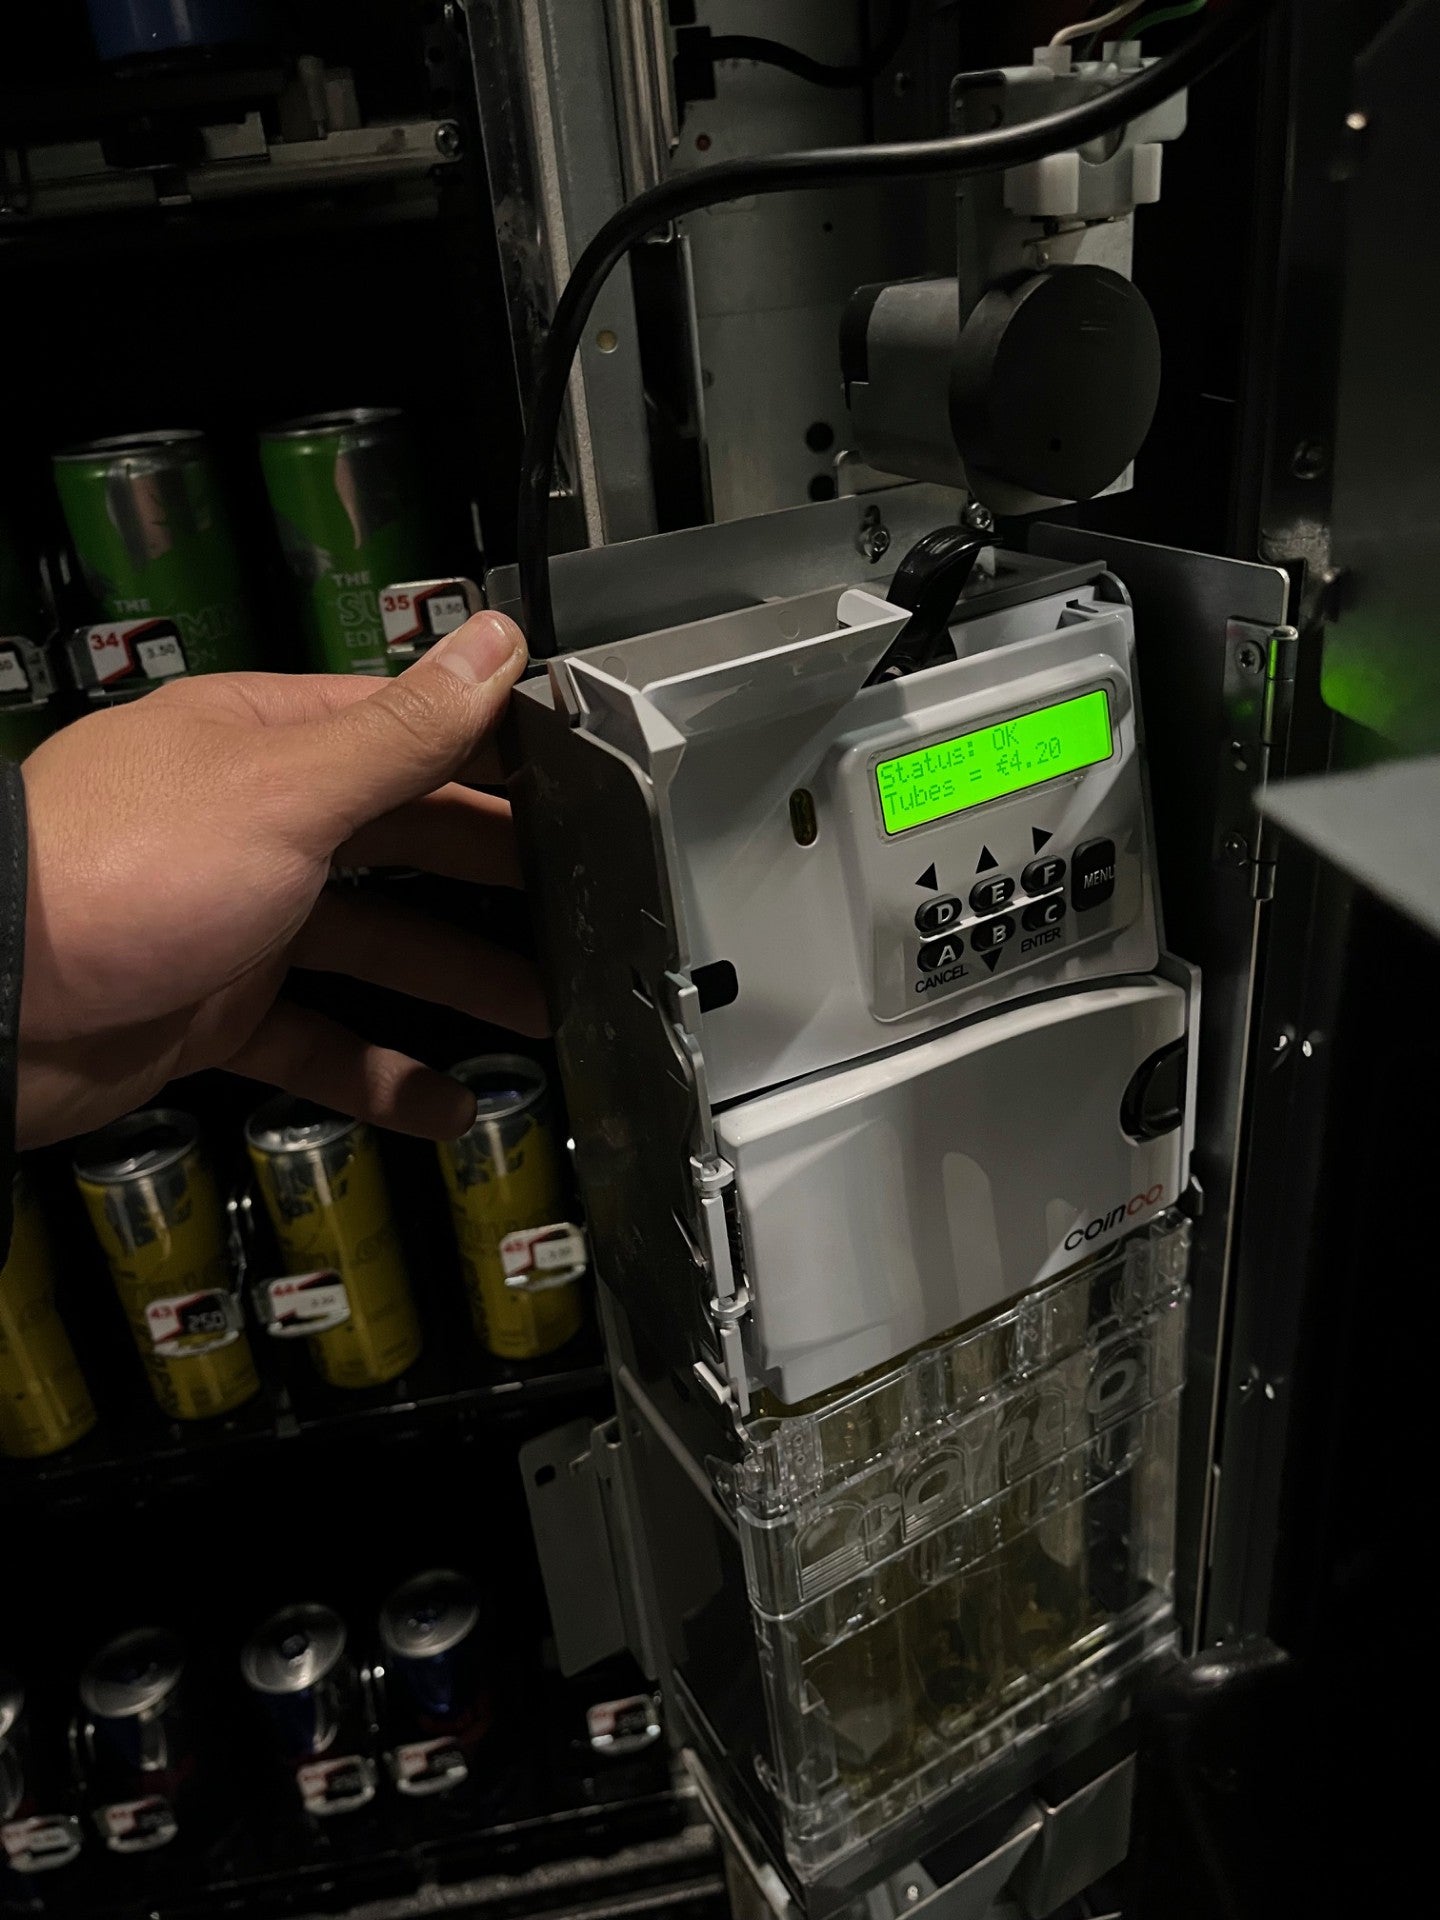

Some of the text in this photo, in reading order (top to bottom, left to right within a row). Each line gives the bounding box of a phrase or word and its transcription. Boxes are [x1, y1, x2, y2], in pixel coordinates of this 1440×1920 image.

[384, 595, 411, 612] 35
[91, 632, 119, 650] 34
[881, 722, 1020, 789] Status: OK
[884, 779, 956, 815] Tubes
[996, 736, 1062, 777] €4.20
[1043, 864, 1056, 884] F
[991, 882, 1005, 901] E
[937, 903, 954, 924] D
[1044, 905, 1058, 924] C
[992, 926, 1007, 945] B
[1020, 927, 1062, 953] ENTER
[937, 945, 957, 967] A
[915, 965, 969, 994] CANCEL
[1063, 1183, 1164, 1251] coinco
